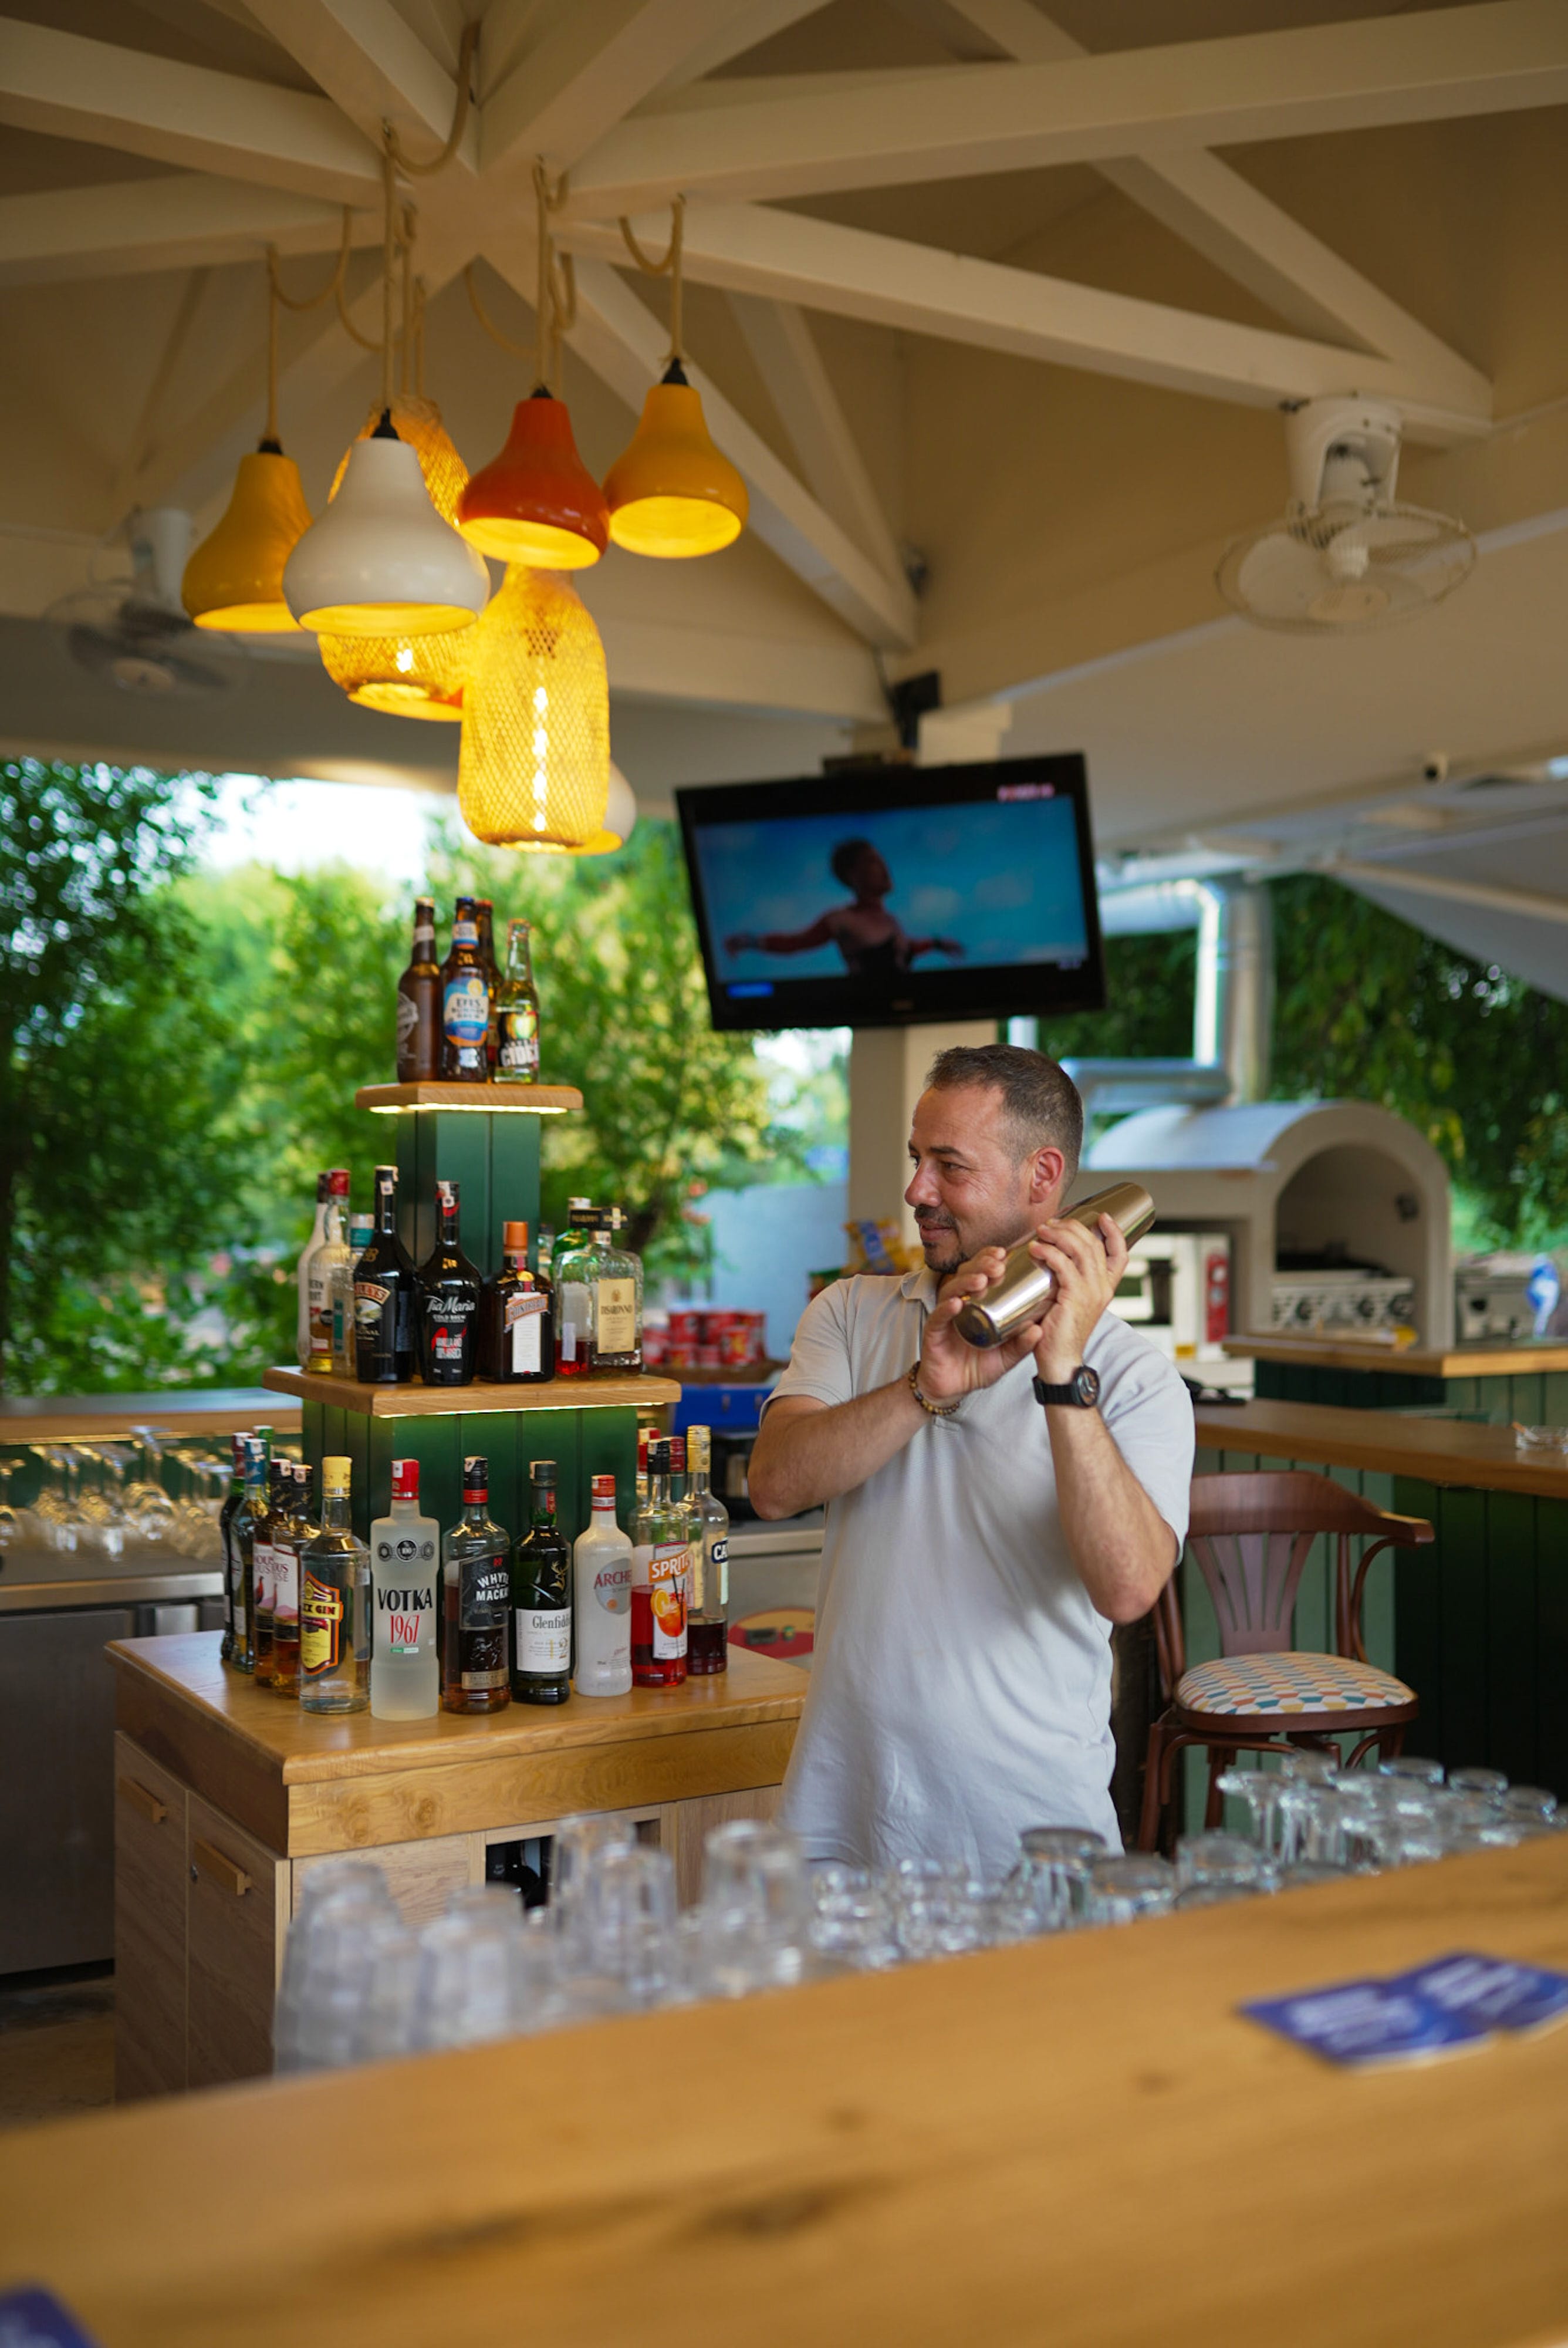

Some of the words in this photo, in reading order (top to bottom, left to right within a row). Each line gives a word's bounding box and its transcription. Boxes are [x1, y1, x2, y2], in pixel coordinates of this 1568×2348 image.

[315, 1605, 336, 1615] GIN
[377, 1587, 433, 1611] VOTKA
[390, 1615, 420, 1644] 1967
